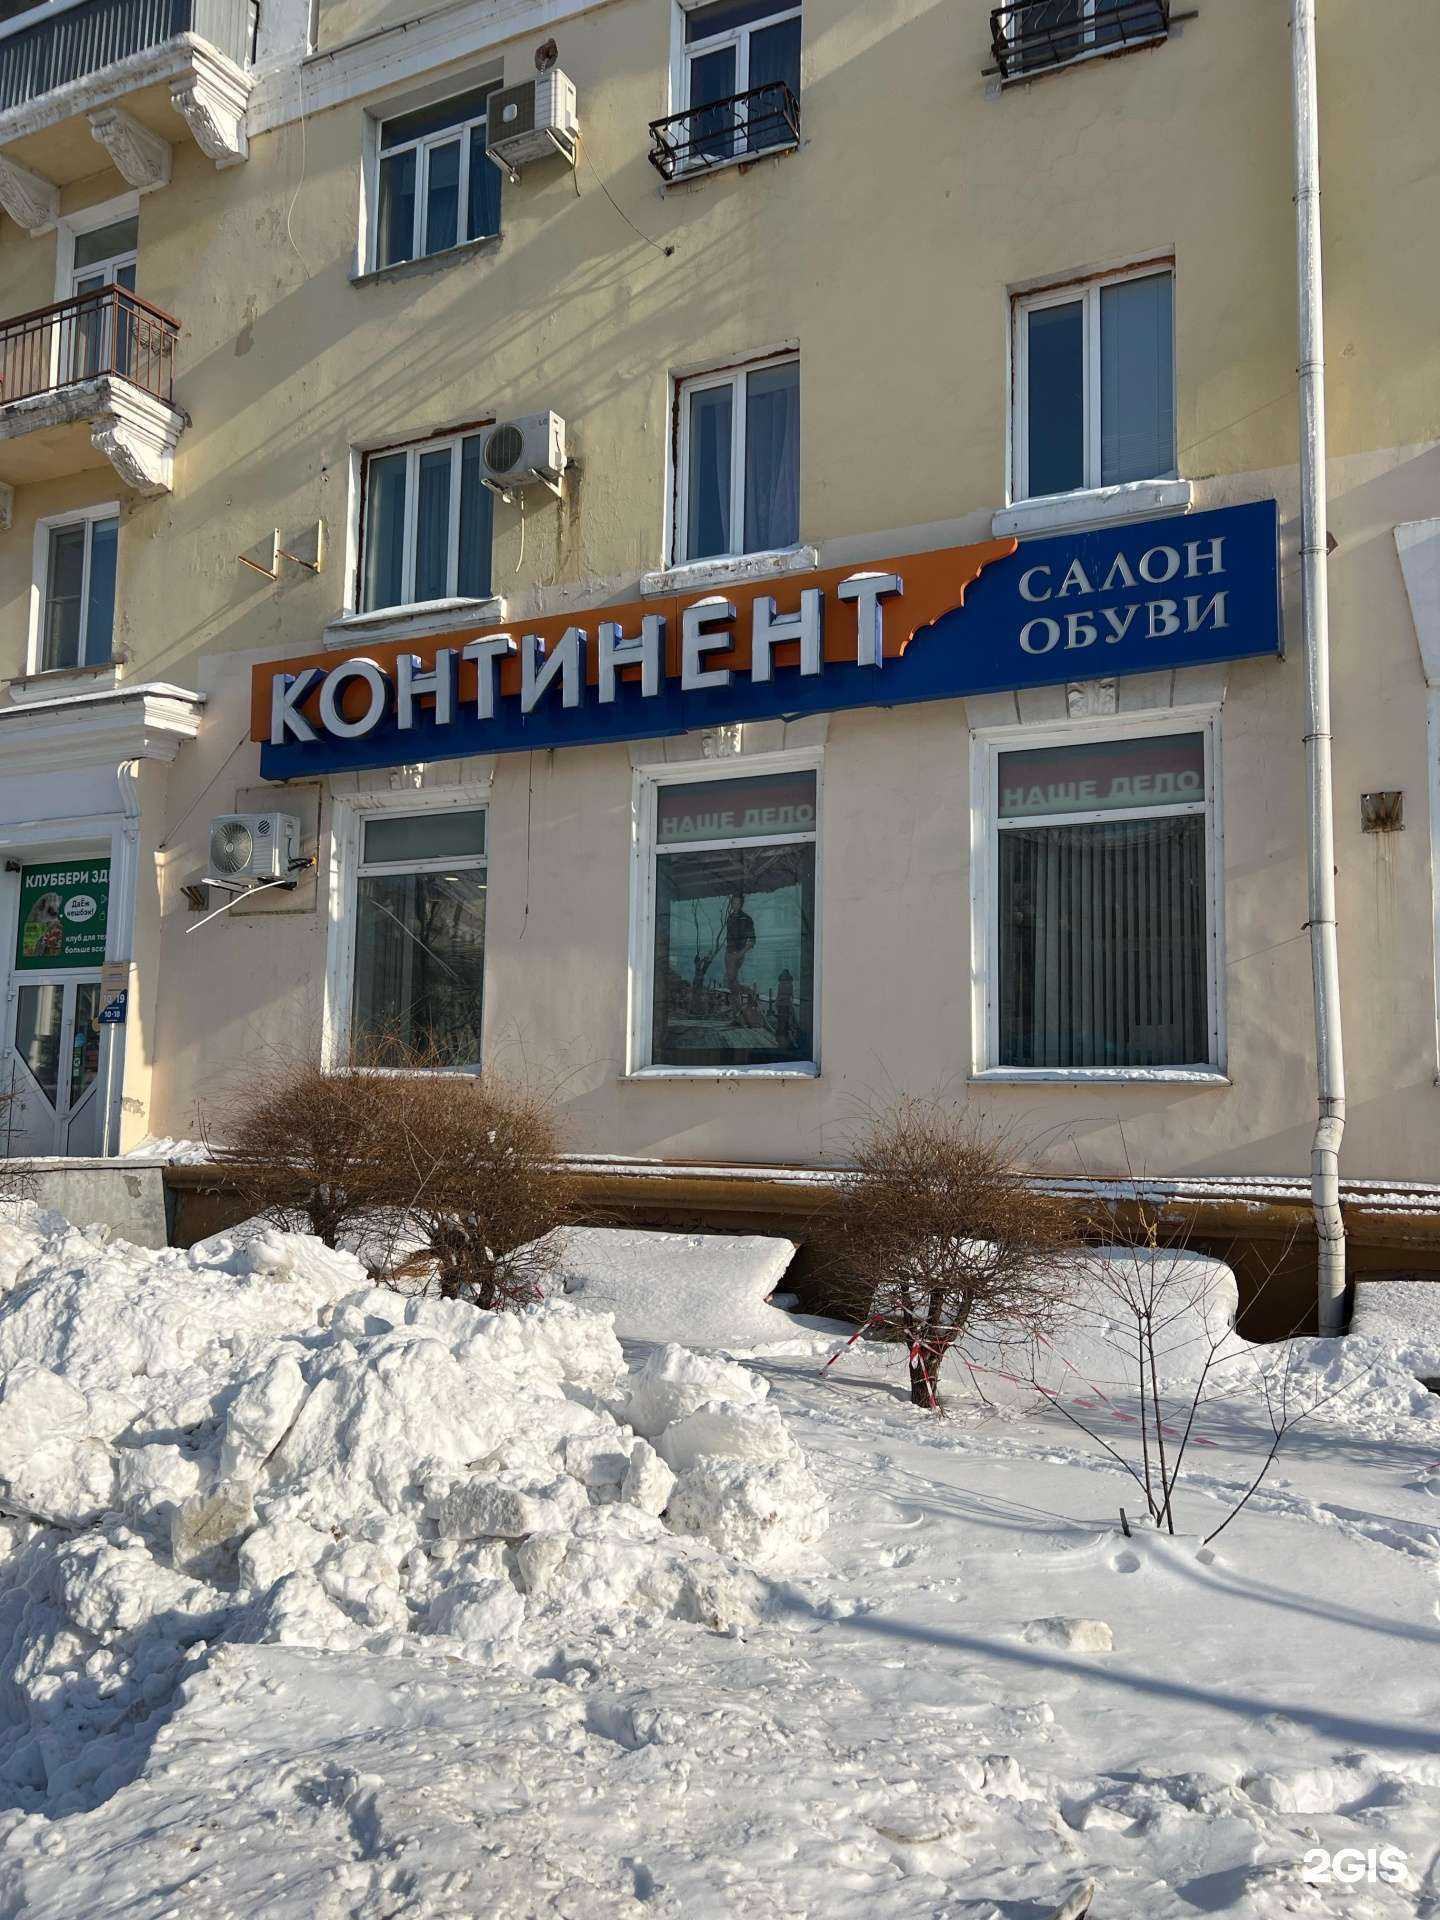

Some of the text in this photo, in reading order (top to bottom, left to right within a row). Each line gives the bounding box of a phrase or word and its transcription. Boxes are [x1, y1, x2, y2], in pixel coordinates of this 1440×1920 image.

[1018, 536, 1228, 603] САЛОН
[1018, 591, 1230, 656] ОБУВИ
[270, 573, 904, 745] КОНТИНЕНТ
[1003, 771, 1199, 806] НАШЕ ДЕЛО
[662, 804, 814, 834] НАШЕ ДЕЛО
[25, 869, 110, 888] КЛУББЕРИ ЗД
[66, 933, 82, 943] клуб
